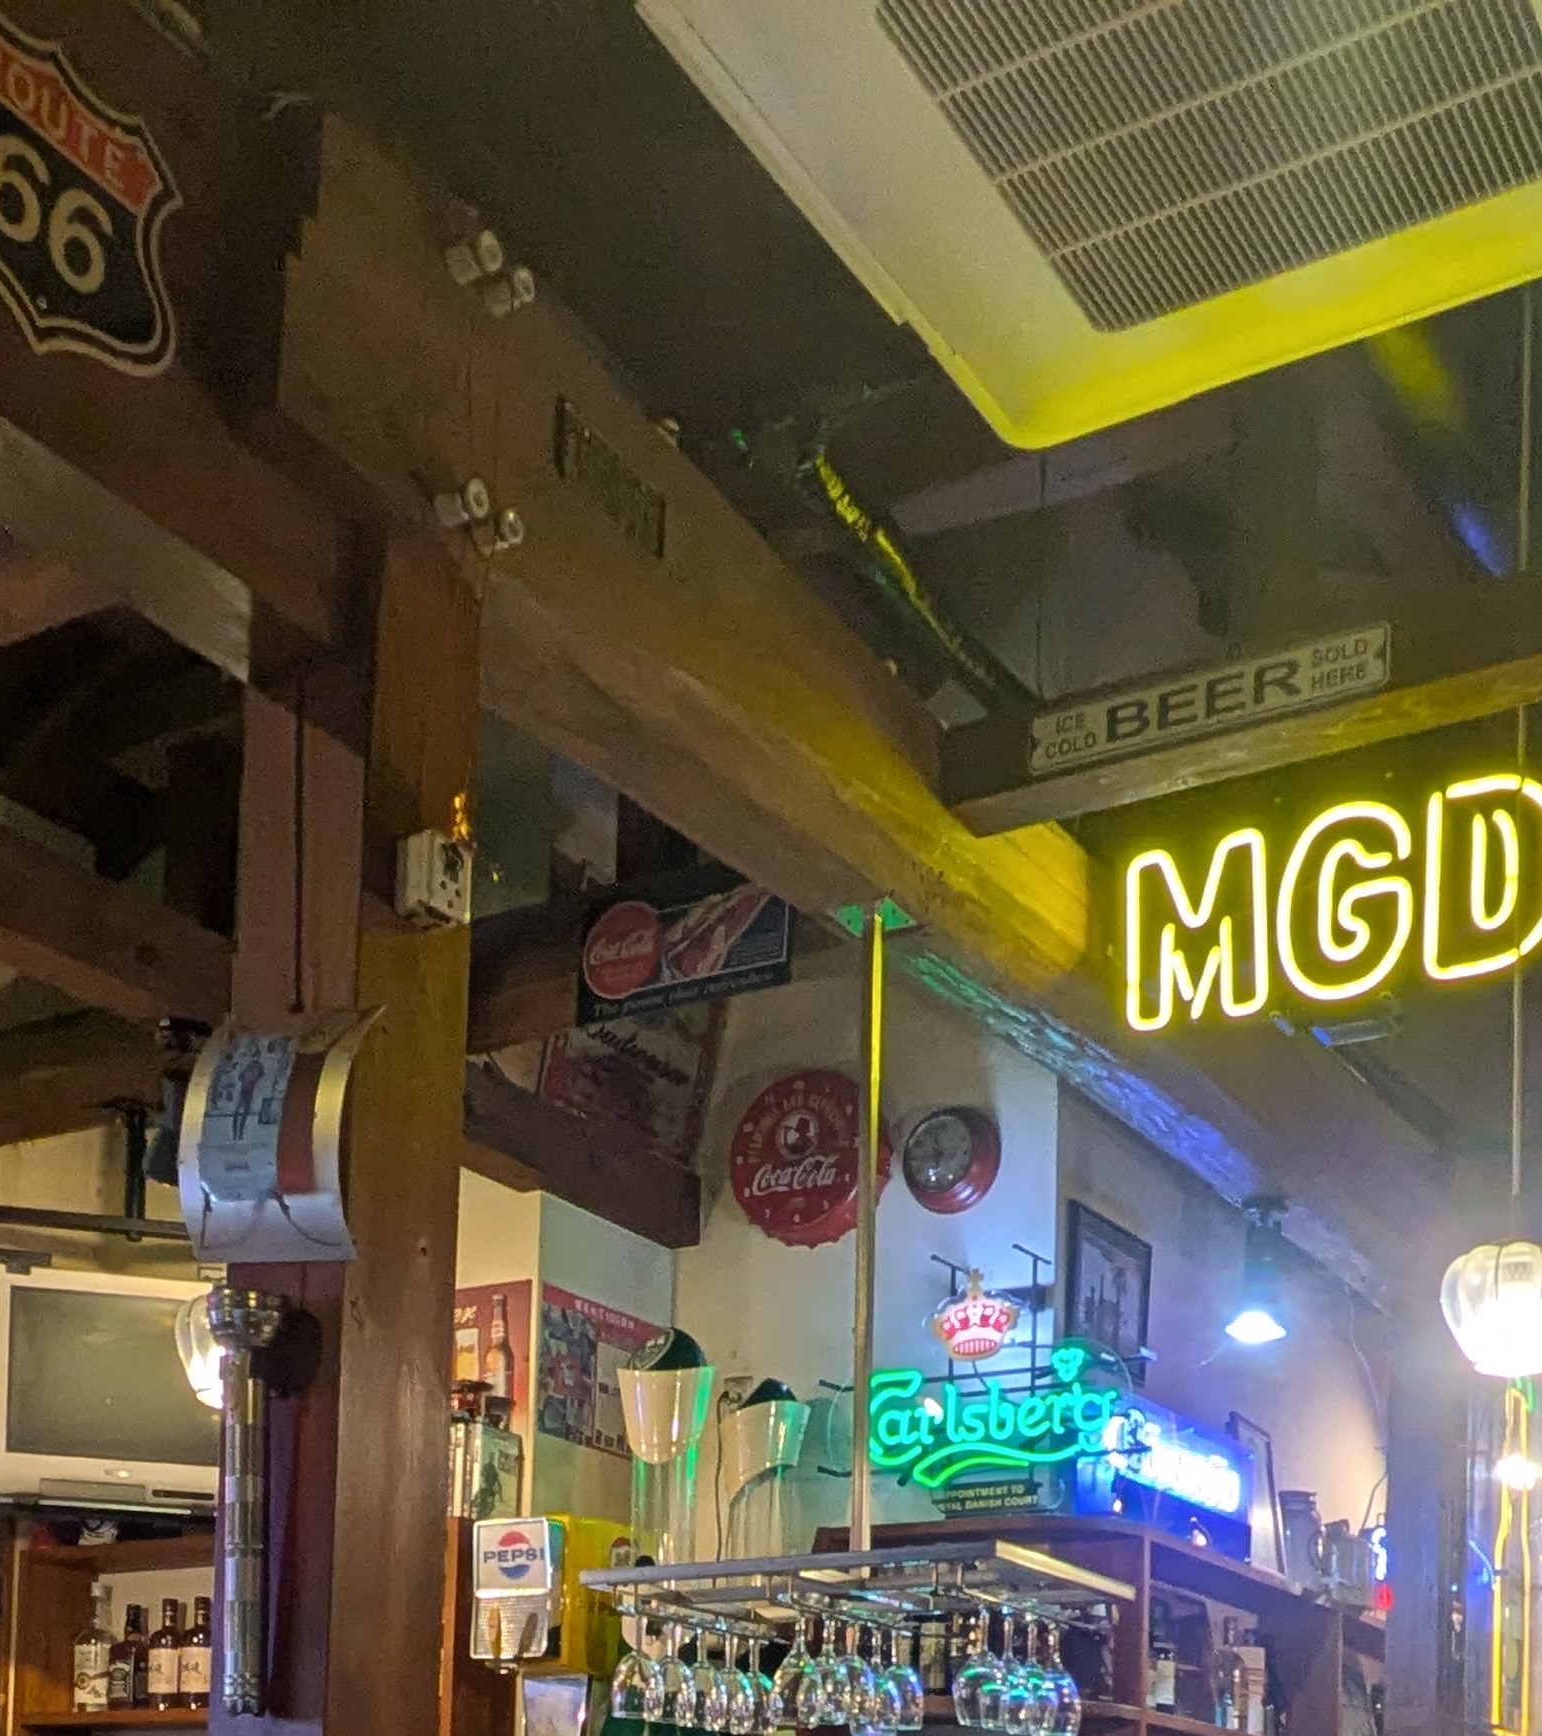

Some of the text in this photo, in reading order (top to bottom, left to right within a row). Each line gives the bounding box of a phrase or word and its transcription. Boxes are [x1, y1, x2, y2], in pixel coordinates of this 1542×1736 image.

[1310, 637, 1370, 668] SOLD
[1309, 662, 1367, 694] HERE
[1104, 656, 1305, 745] BEER
[1054, 713, 1087, 733] ICE
[1045, 731, 1098, 760] COLD
[868, 1368, 1119, 1467] Carlsberg
[482, 1546, 545, 1565] PEPSI
